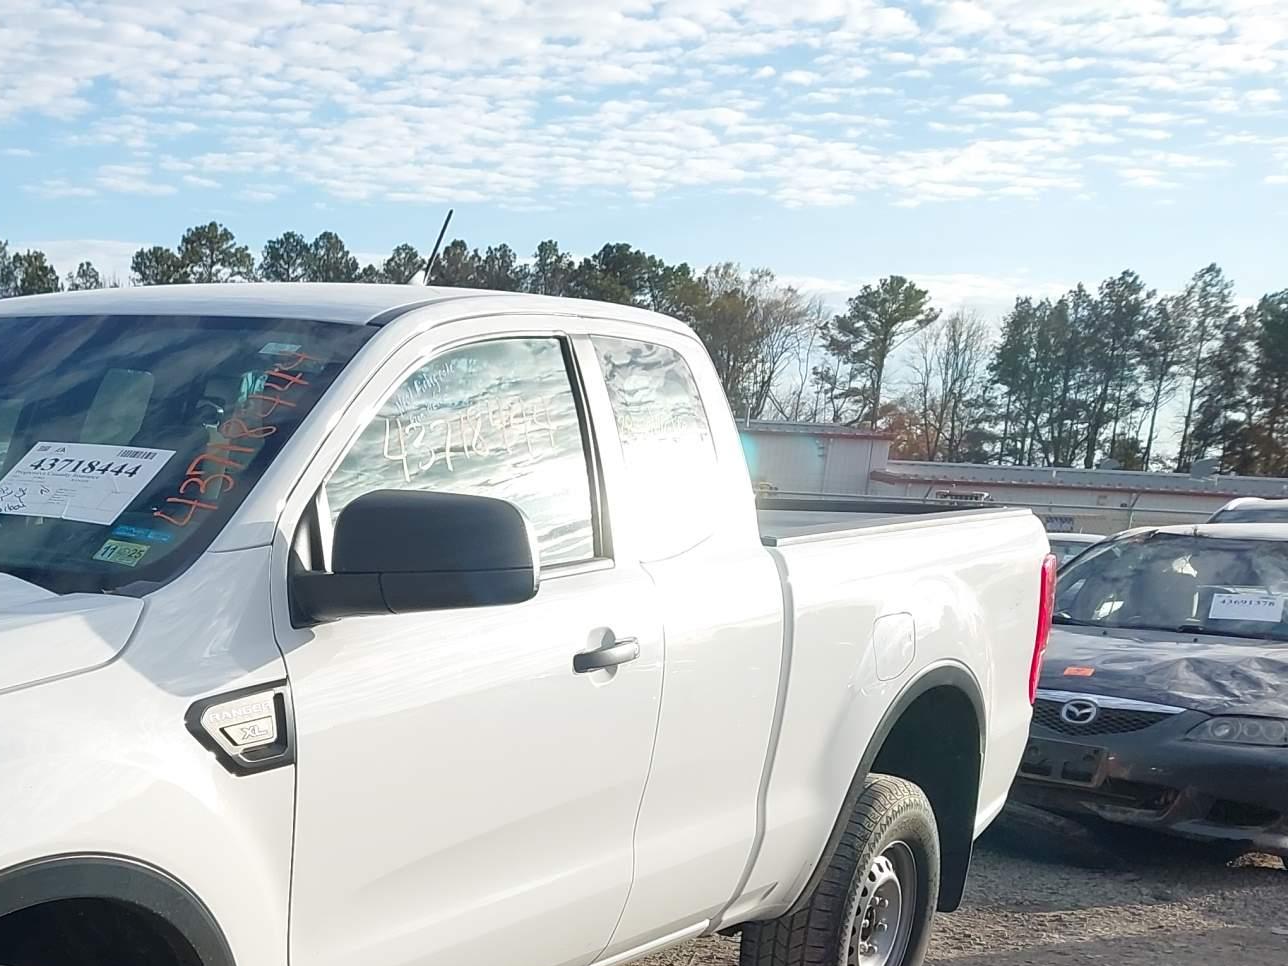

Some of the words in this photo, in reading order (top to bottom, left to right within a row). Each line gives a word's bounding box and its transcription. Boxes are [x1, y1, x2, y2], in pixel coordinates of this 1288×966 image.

[383, 397, 560, 483] 43718444
[30, 457, 142, 478] 43718444
[100, 544, 119, 559] 11
[127, 548, 145, 560] 25
[240, 724, 269, 741] XL
